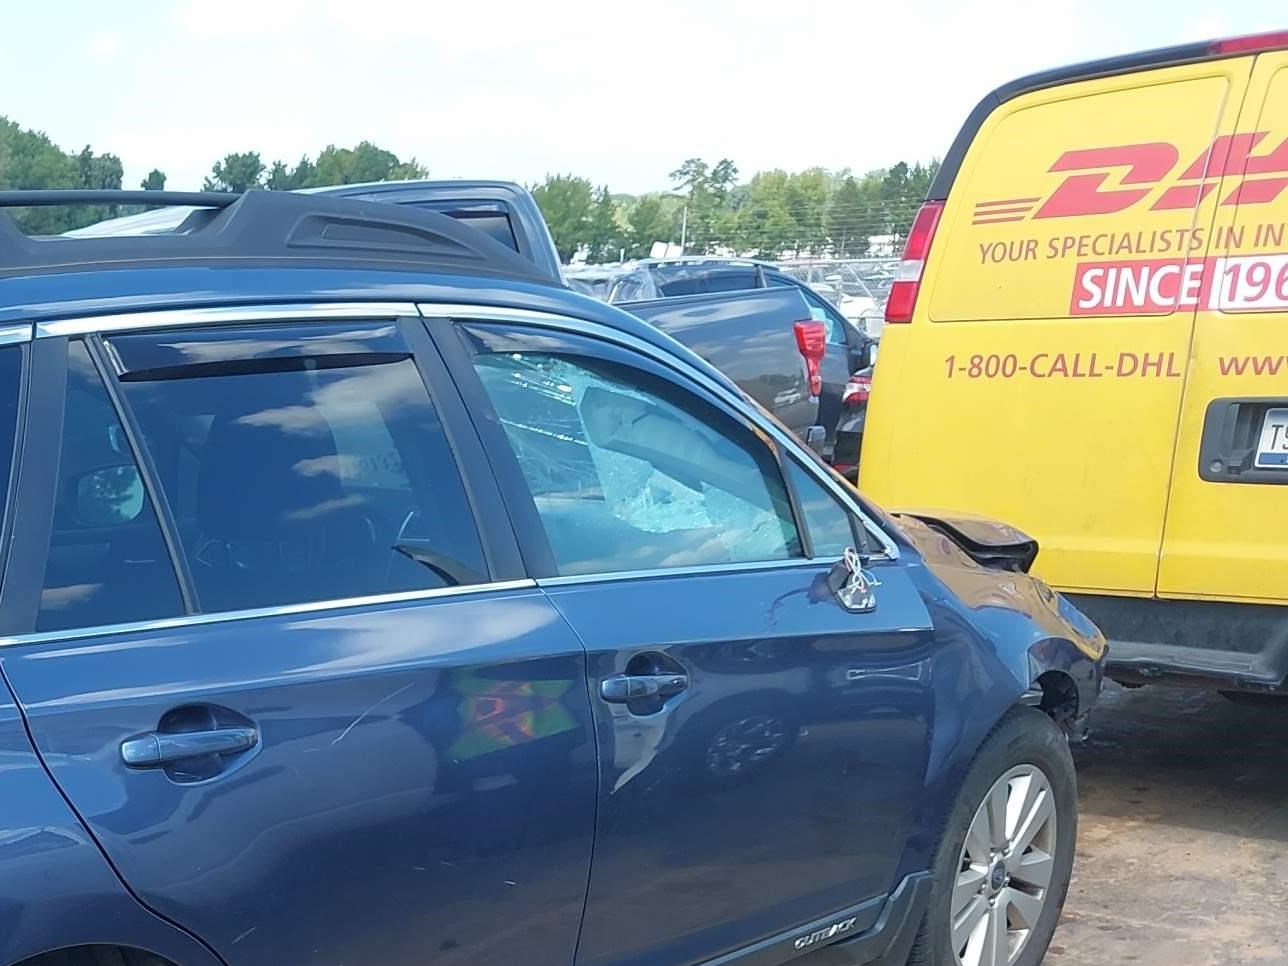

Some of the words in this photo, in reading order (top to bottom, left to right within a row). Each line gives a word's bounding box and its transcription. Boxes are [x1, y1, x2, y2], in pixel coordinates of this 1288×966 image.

[979, 239, 1039, 265] YOUR
[1046, 228, 1205, 260] SPECIALISTS
[1214, 225, 1245, 250] IN
[1253, 222, 1288, 248] IN
[1078, 263, 1204, 309] SINCE
[944, 351, 1182, 379] 1-800-CALL-DHL
[1218, 355, 1288, 376] ww
[794, 916, 857, 949] OUTBACK
